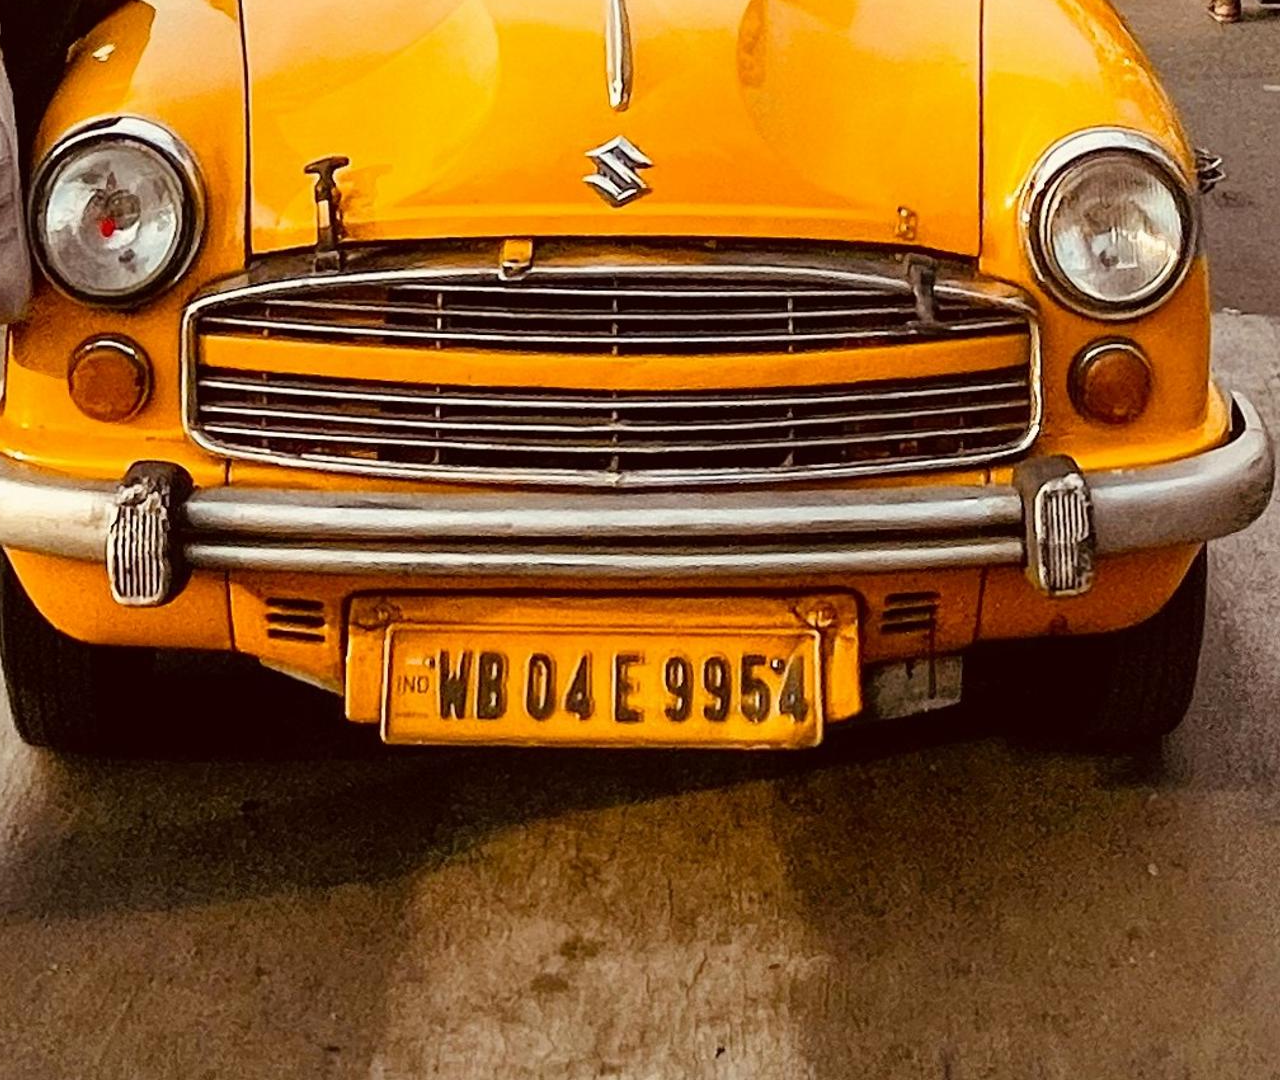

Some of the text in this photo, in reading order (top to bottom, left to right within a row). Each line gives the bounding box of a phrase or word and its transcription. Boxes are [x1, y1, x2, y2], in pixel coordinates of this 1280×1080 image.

[397, 675, 430, 695] IND
[439, 650, 810, 724] WB 04 E 9954
